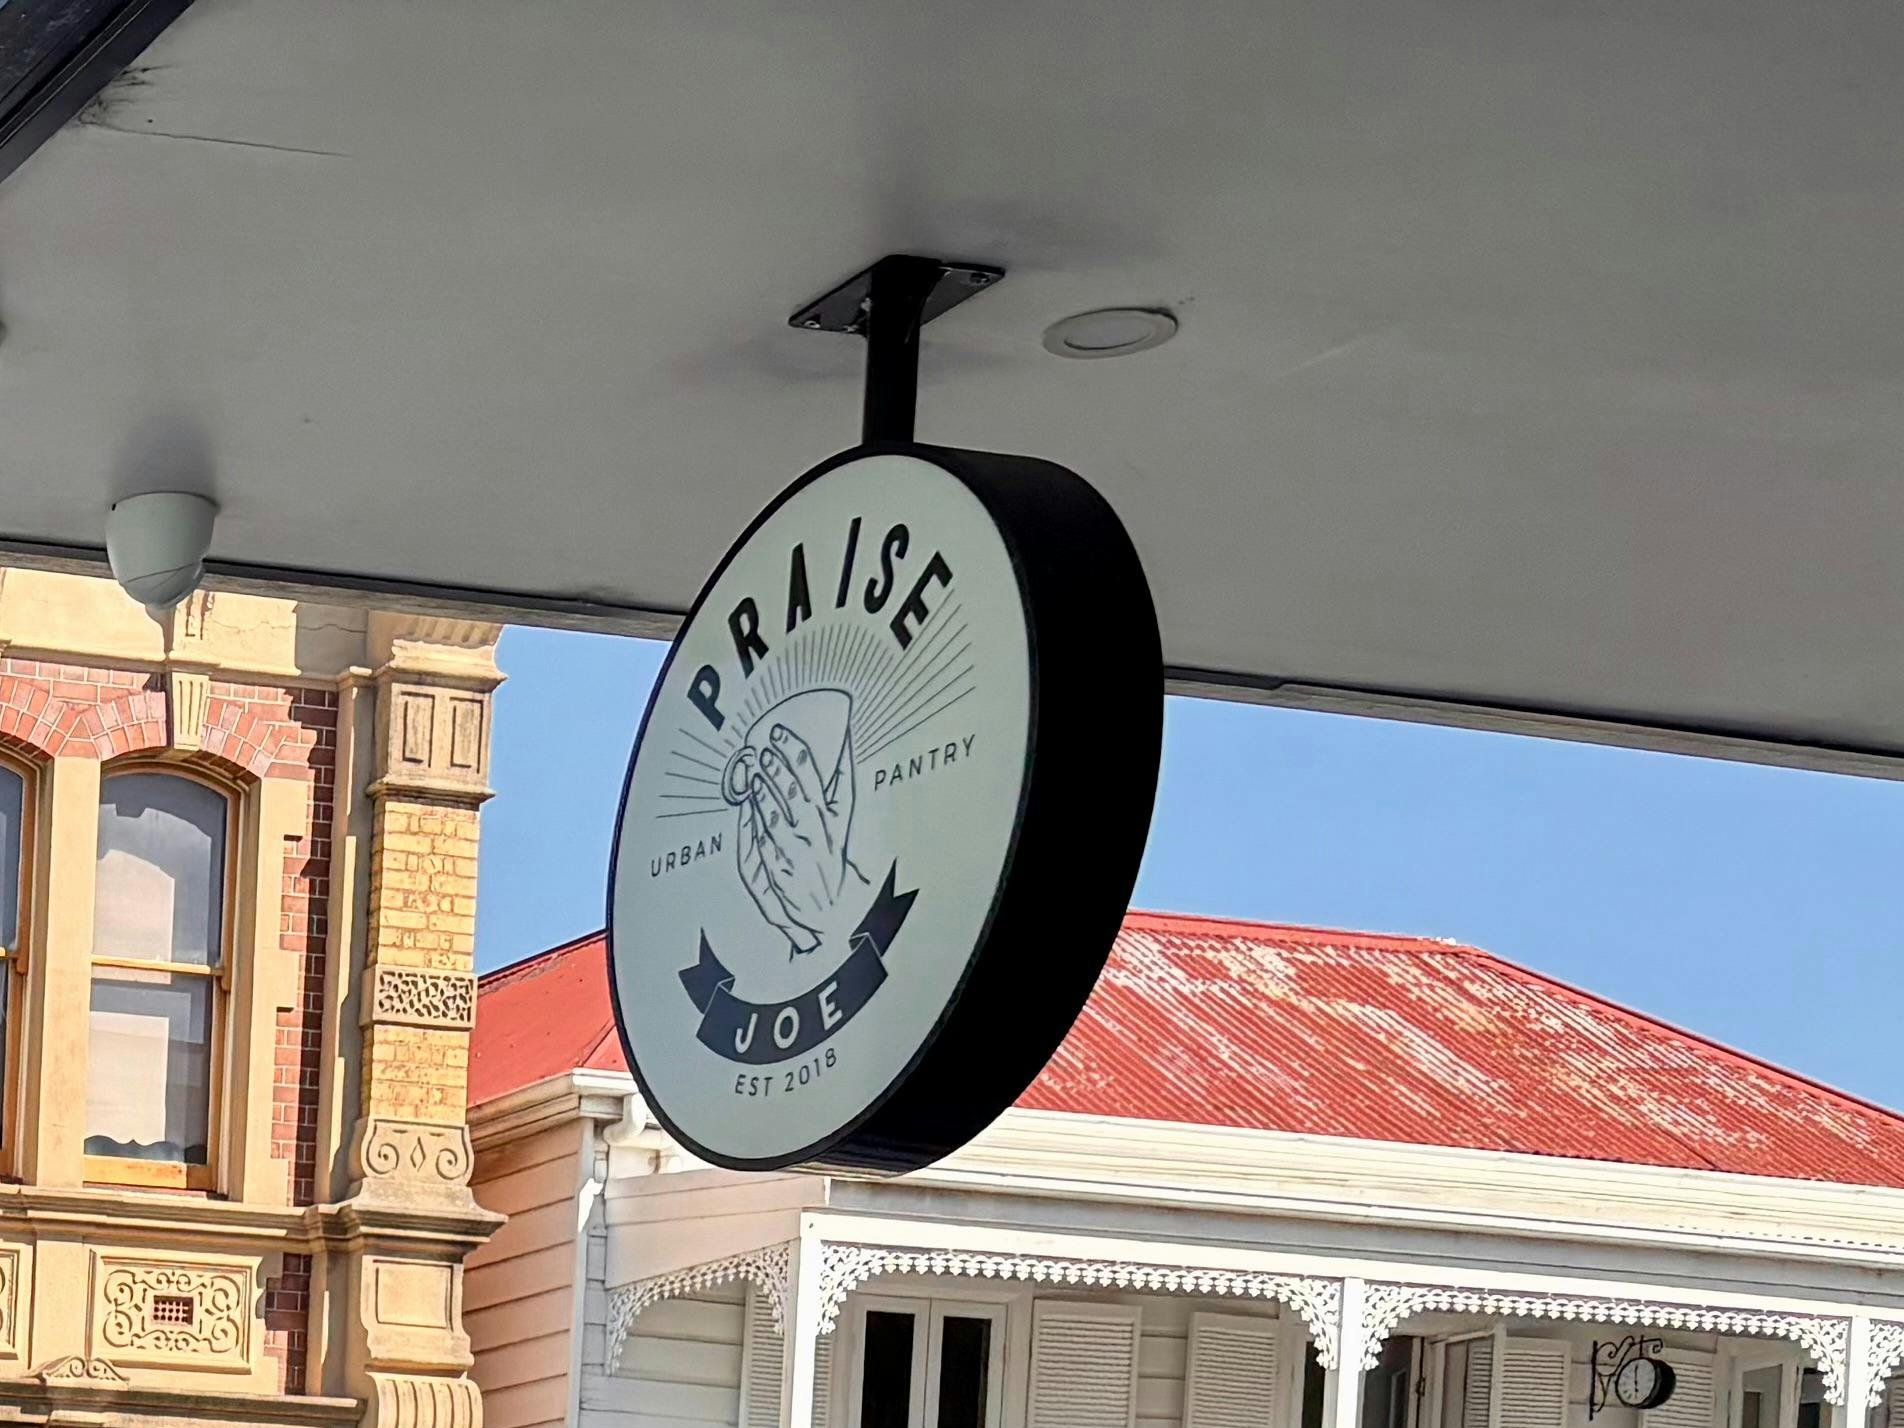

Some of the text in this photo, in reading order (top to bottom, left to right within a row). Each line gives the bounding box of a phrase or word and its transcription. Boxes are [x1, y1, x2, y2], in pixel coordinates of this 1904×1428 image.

[686, 516, 954, 731] PRAISE
[873, 733, 976, 792] PANTRY
[649, 832, 723, 879] URBAN
[734, 980, 843, 1054] JOE
[734, 1047, 838, 1097] EST 2018
